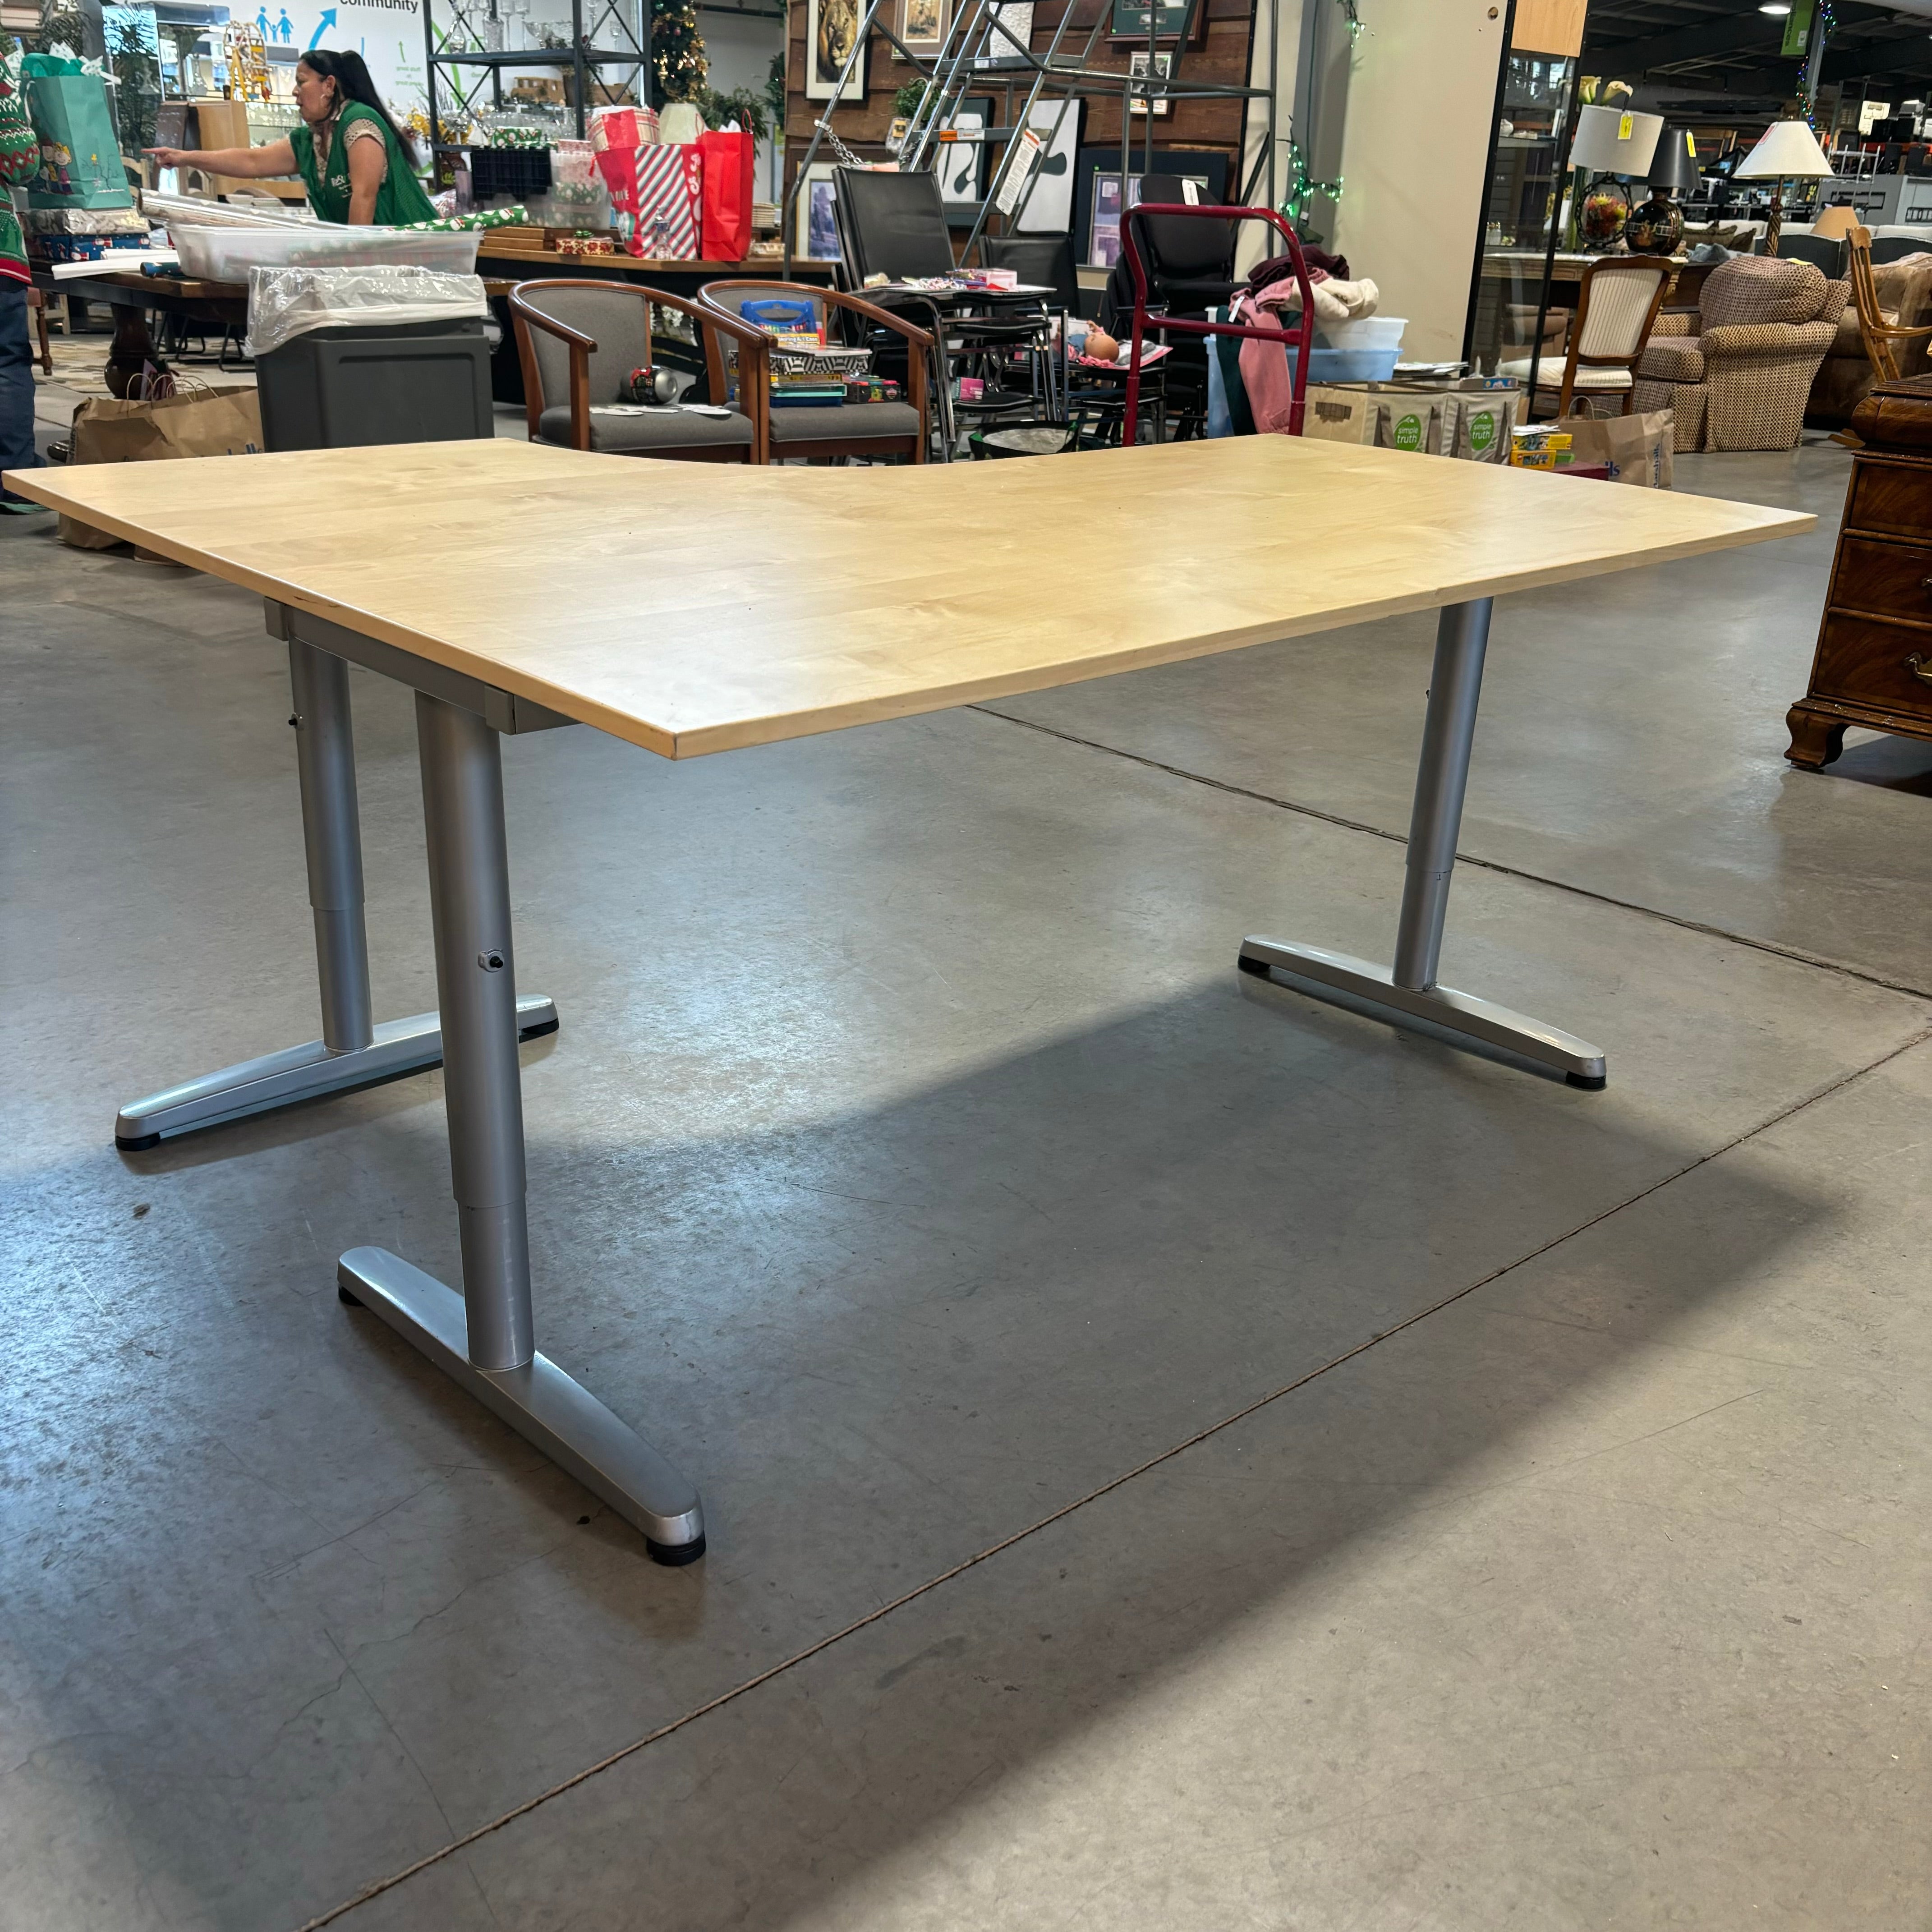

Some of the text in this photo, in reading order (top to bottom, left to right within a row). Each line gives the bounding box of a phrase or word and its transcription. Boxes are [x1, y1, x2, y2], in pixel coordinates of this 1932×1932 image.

[1474, 423, 1492, 432] simple
[1397, 435, 1417, 444] truth
[1472, 431, 1490, 439] truth
